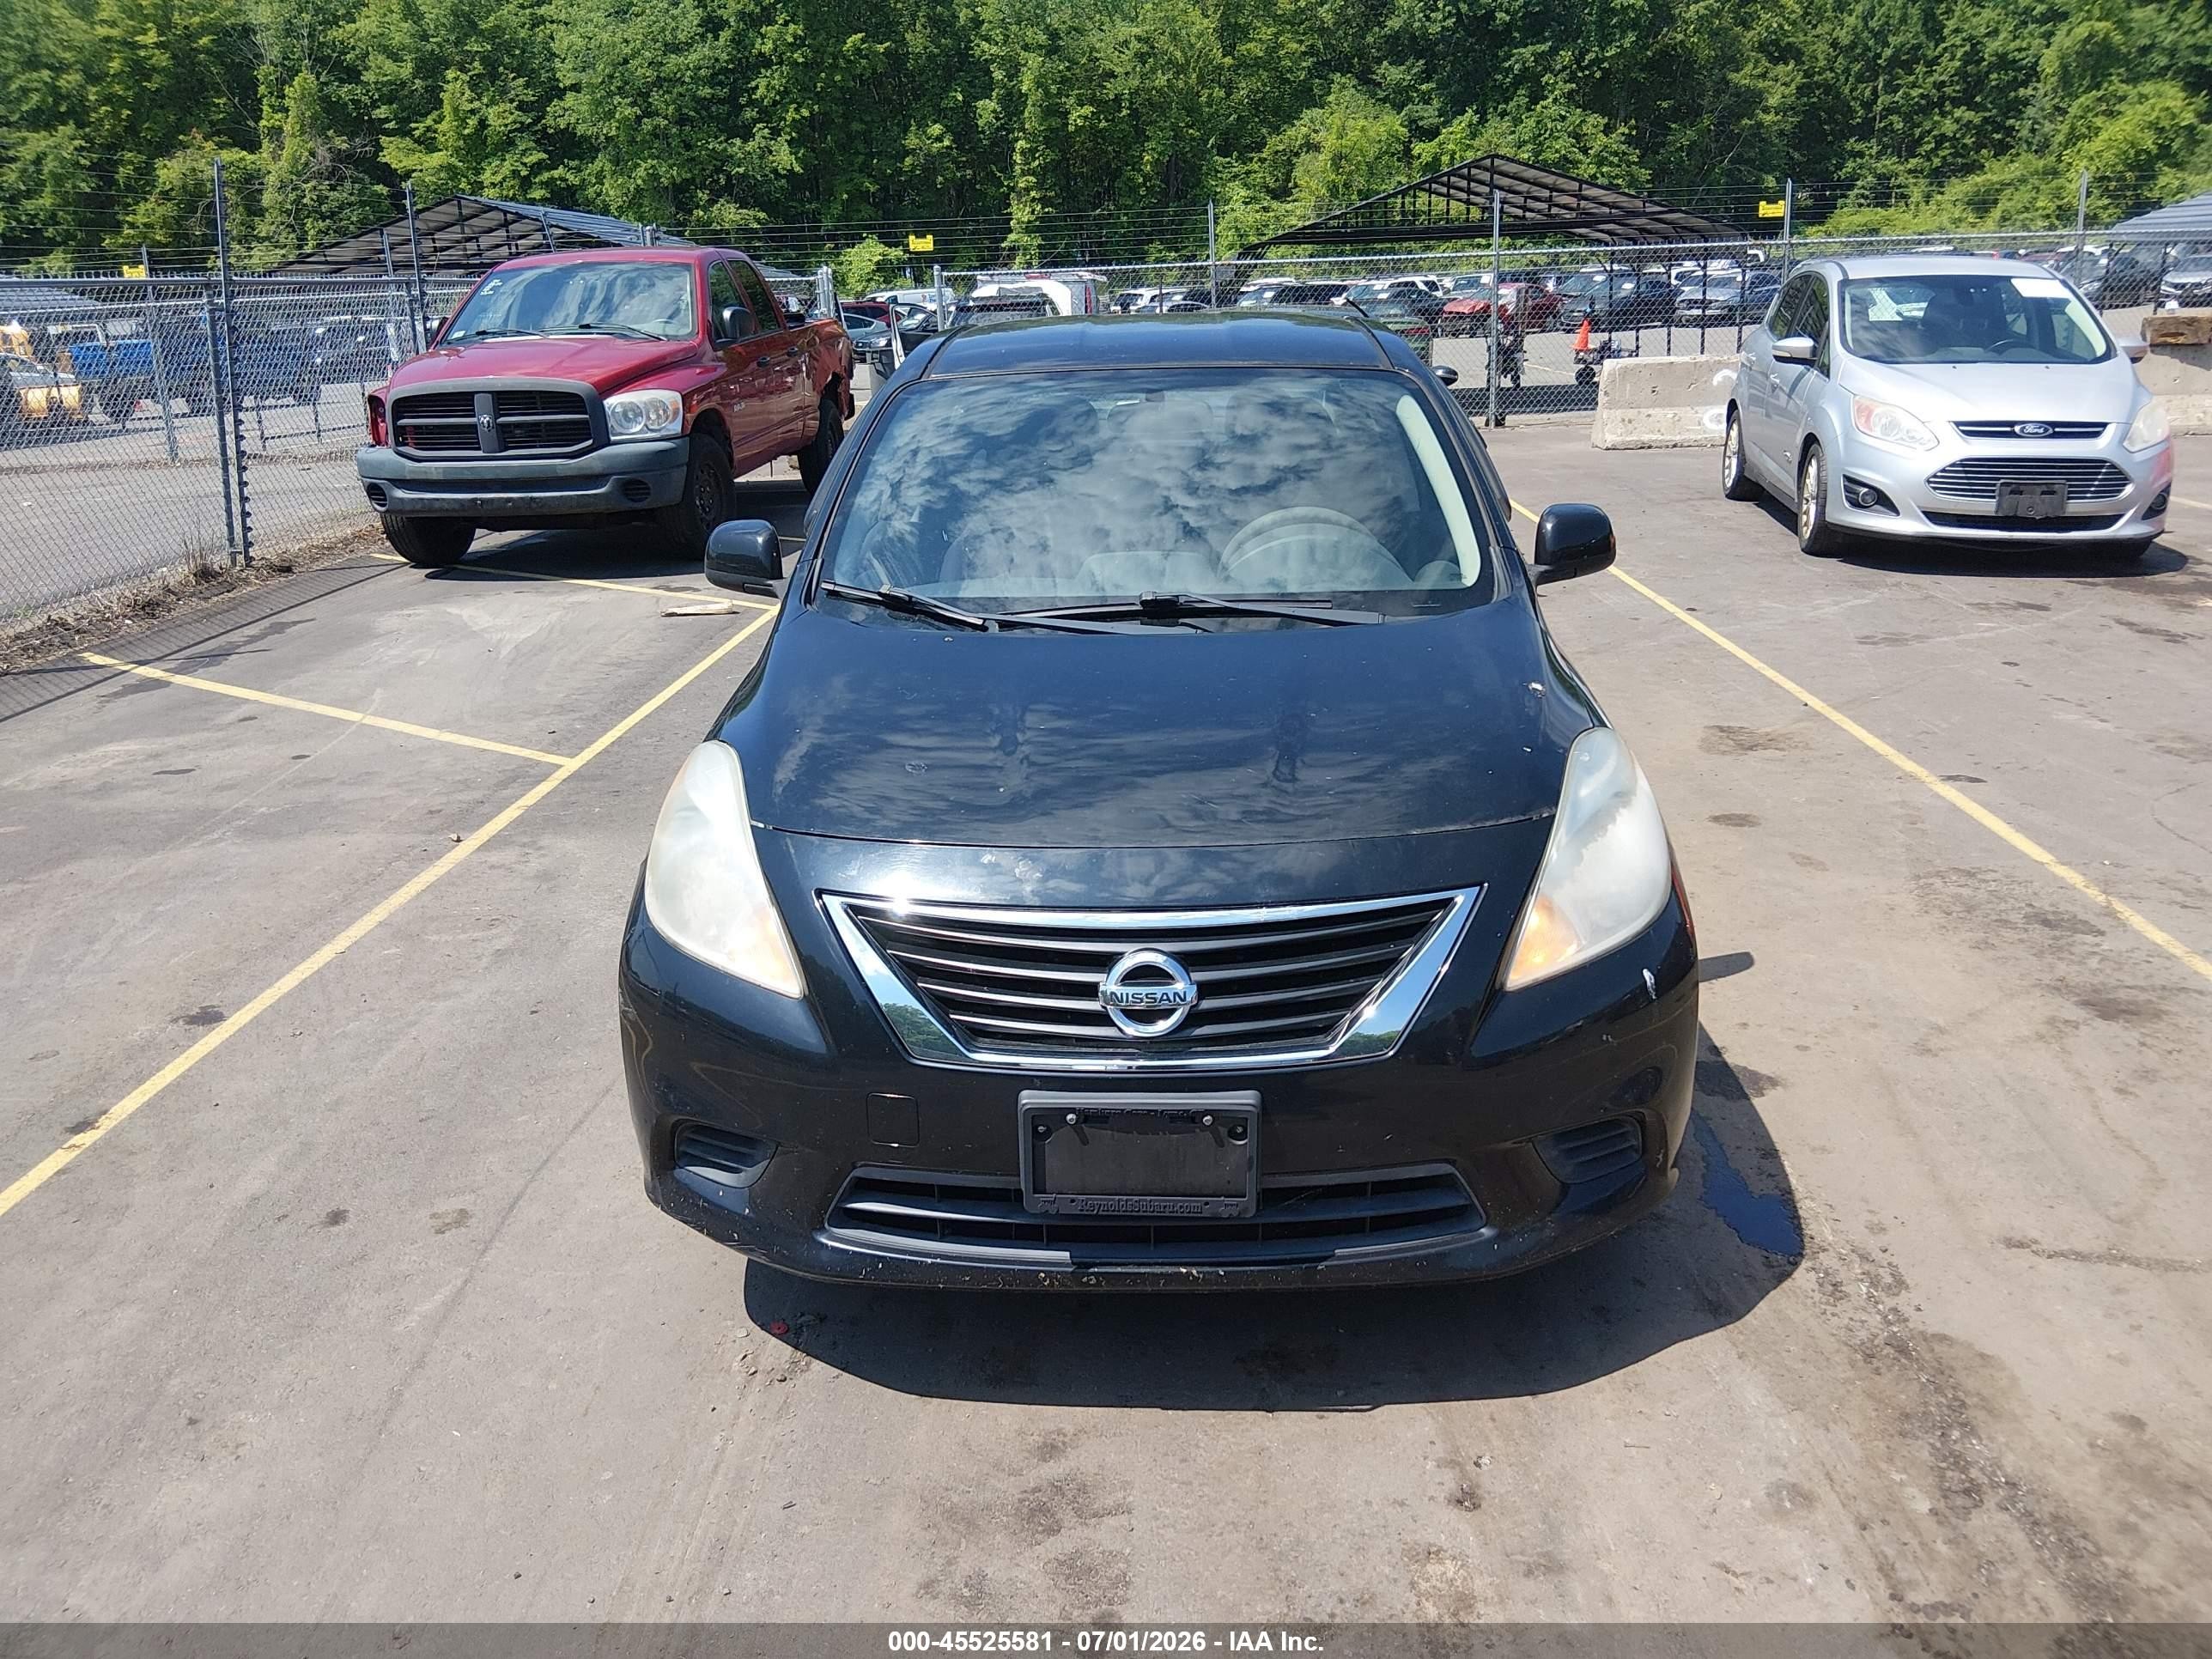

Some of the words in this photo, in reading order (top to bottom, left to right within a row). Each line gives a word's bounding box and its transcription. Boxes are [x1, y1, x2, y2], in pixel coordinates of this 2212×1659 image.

[2023, 424, 2045, 434] Ford
[1109, 990, 1188, 1005] NISSAN
[1079, 1197, 1203, 1215] ReynoldsSubaru.com
